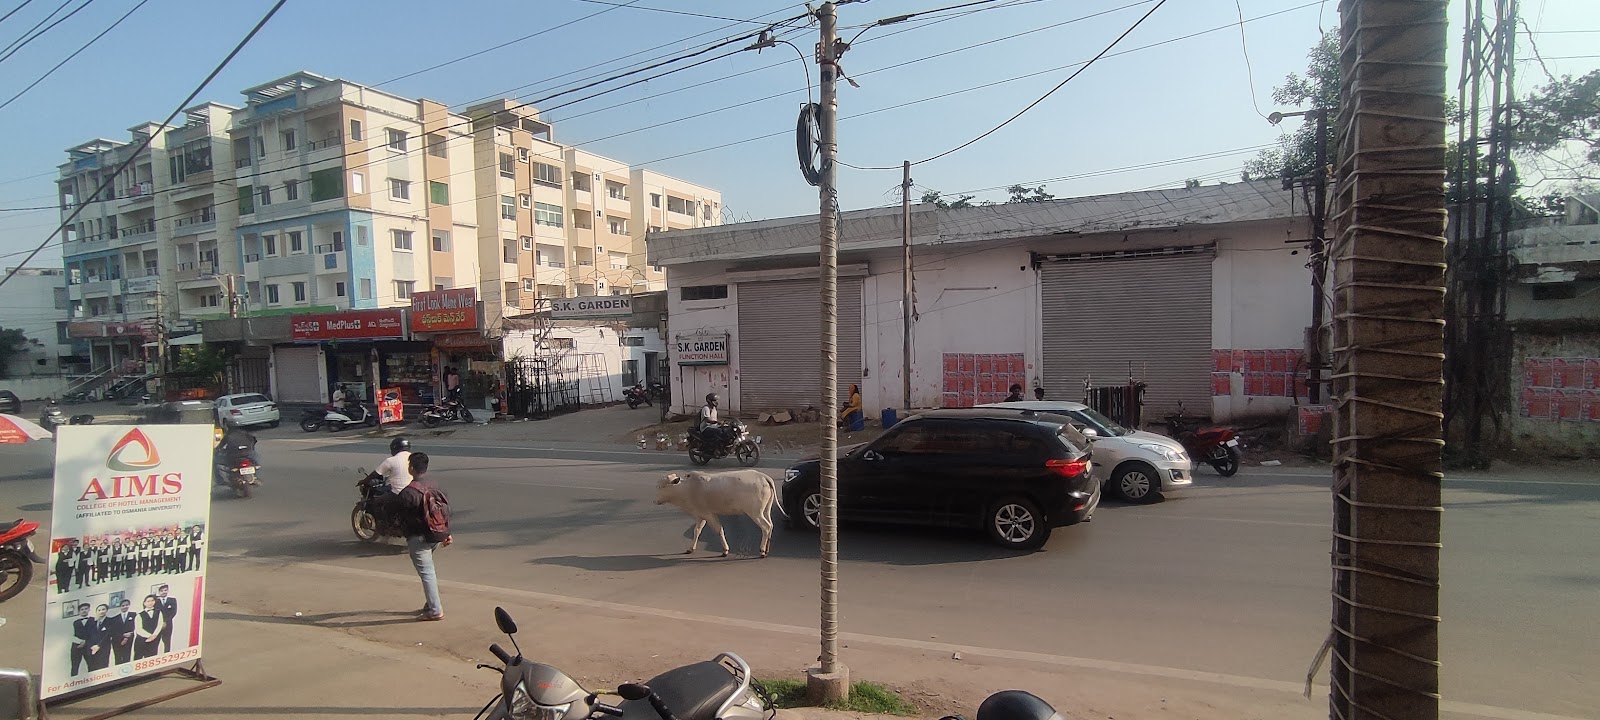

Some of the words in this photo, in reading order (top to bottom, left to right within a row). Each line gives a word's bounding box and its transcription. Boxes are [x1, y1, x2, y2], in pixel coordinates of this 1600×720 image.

[412, 295, 426, 312] First
[427, 294, 441, 310] Look
[442, 293, 457, 309] Mens
[458, 293, 474, 309] Wear
[553, 302, 575, 311] S.K.
[578, 299, 630, 310] GARDEN
[326, 320, 355, 330] MedPlus
[677, 342, 692, 352] S.K.
[694, 341, 725, 352] GARDEN
[77, 472, 182, 502] AIMS
[75, 510, 112, 519] (AFFILIATED
[121, 507, 148, 515] OSMANIA
[148, 503, 181, 512] UNIVERSITY)
[76, 502, 107, 511] COLLEGE
[139, 496, 181, 505] MANAGEMENT
[47, 685, 62, 694] For
[63, 671, 114, 689] Admissions:
[134, 648, 198, 671] 8885529279
